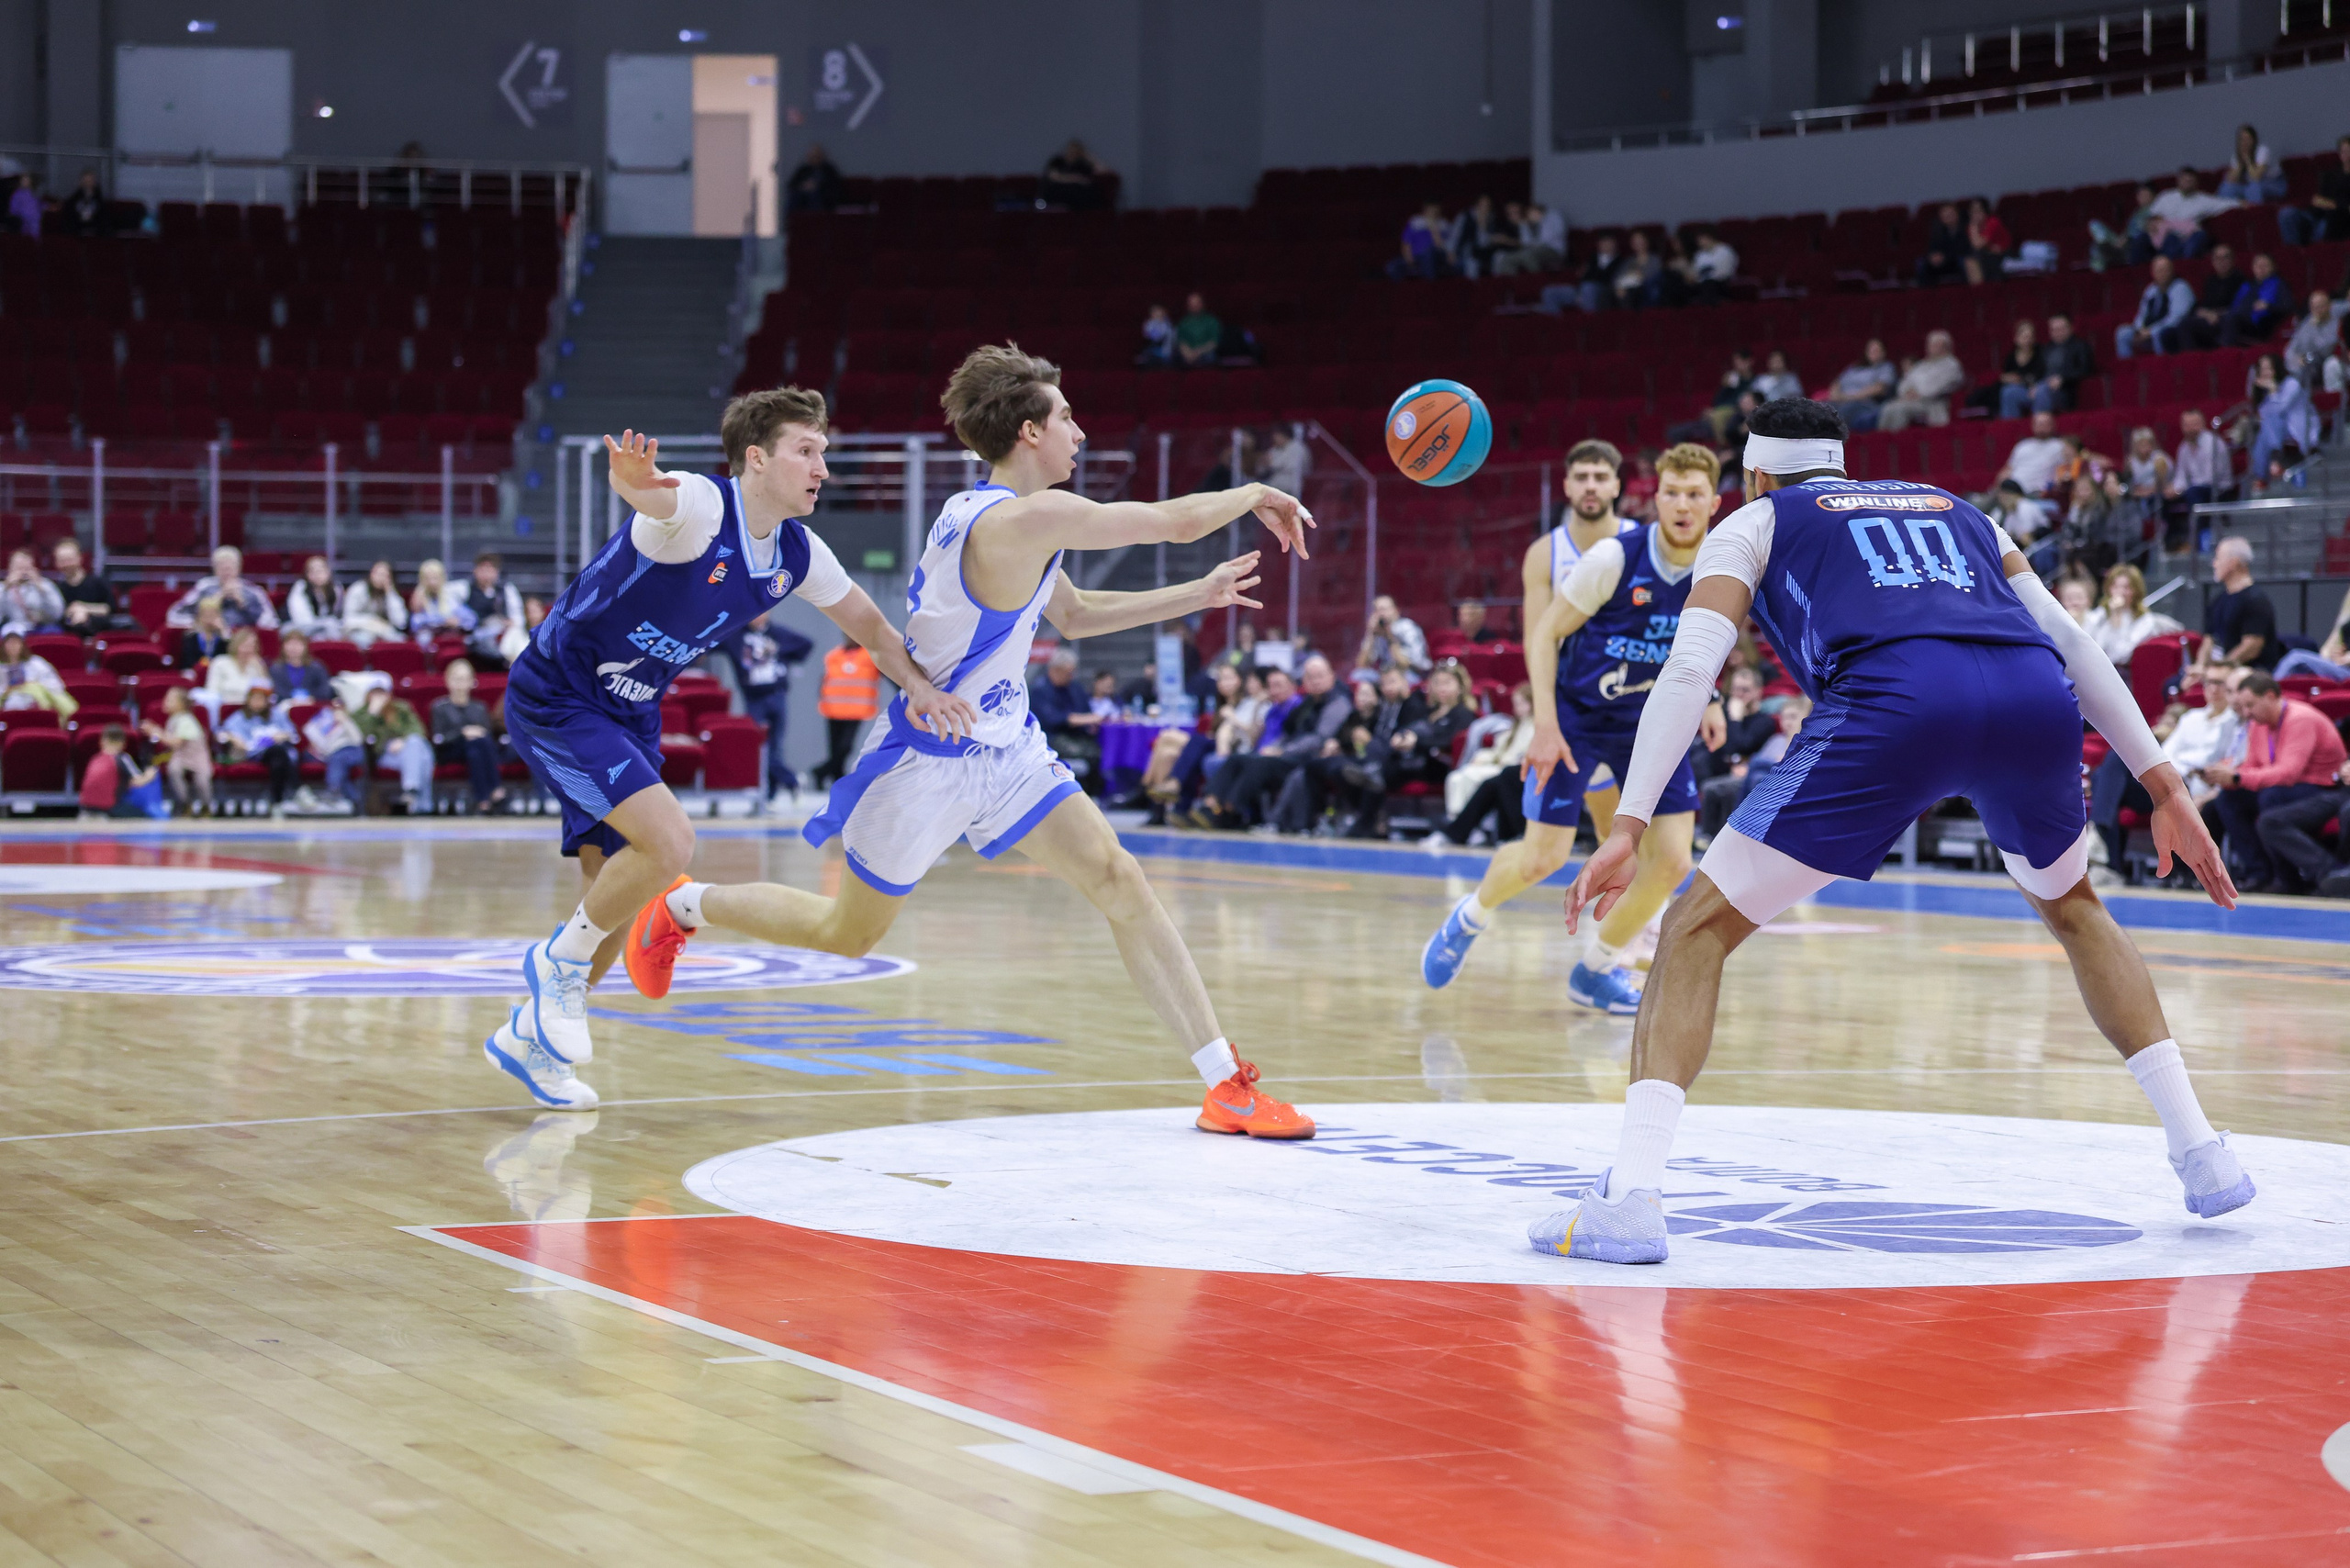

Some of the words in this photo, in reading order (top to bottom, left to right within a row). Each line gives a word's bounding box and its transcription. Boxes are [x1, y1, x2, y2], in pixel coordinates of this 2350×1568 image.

[535, 49, 561, 86] 7
[822, 50, 846, 90] 8
[1827, 496, 1923, 509] WINLINE
[1848, 517, 1975, 592] 00
[626, 621, 719, 665] ZEN
[695, 610, 730, 639] 1
